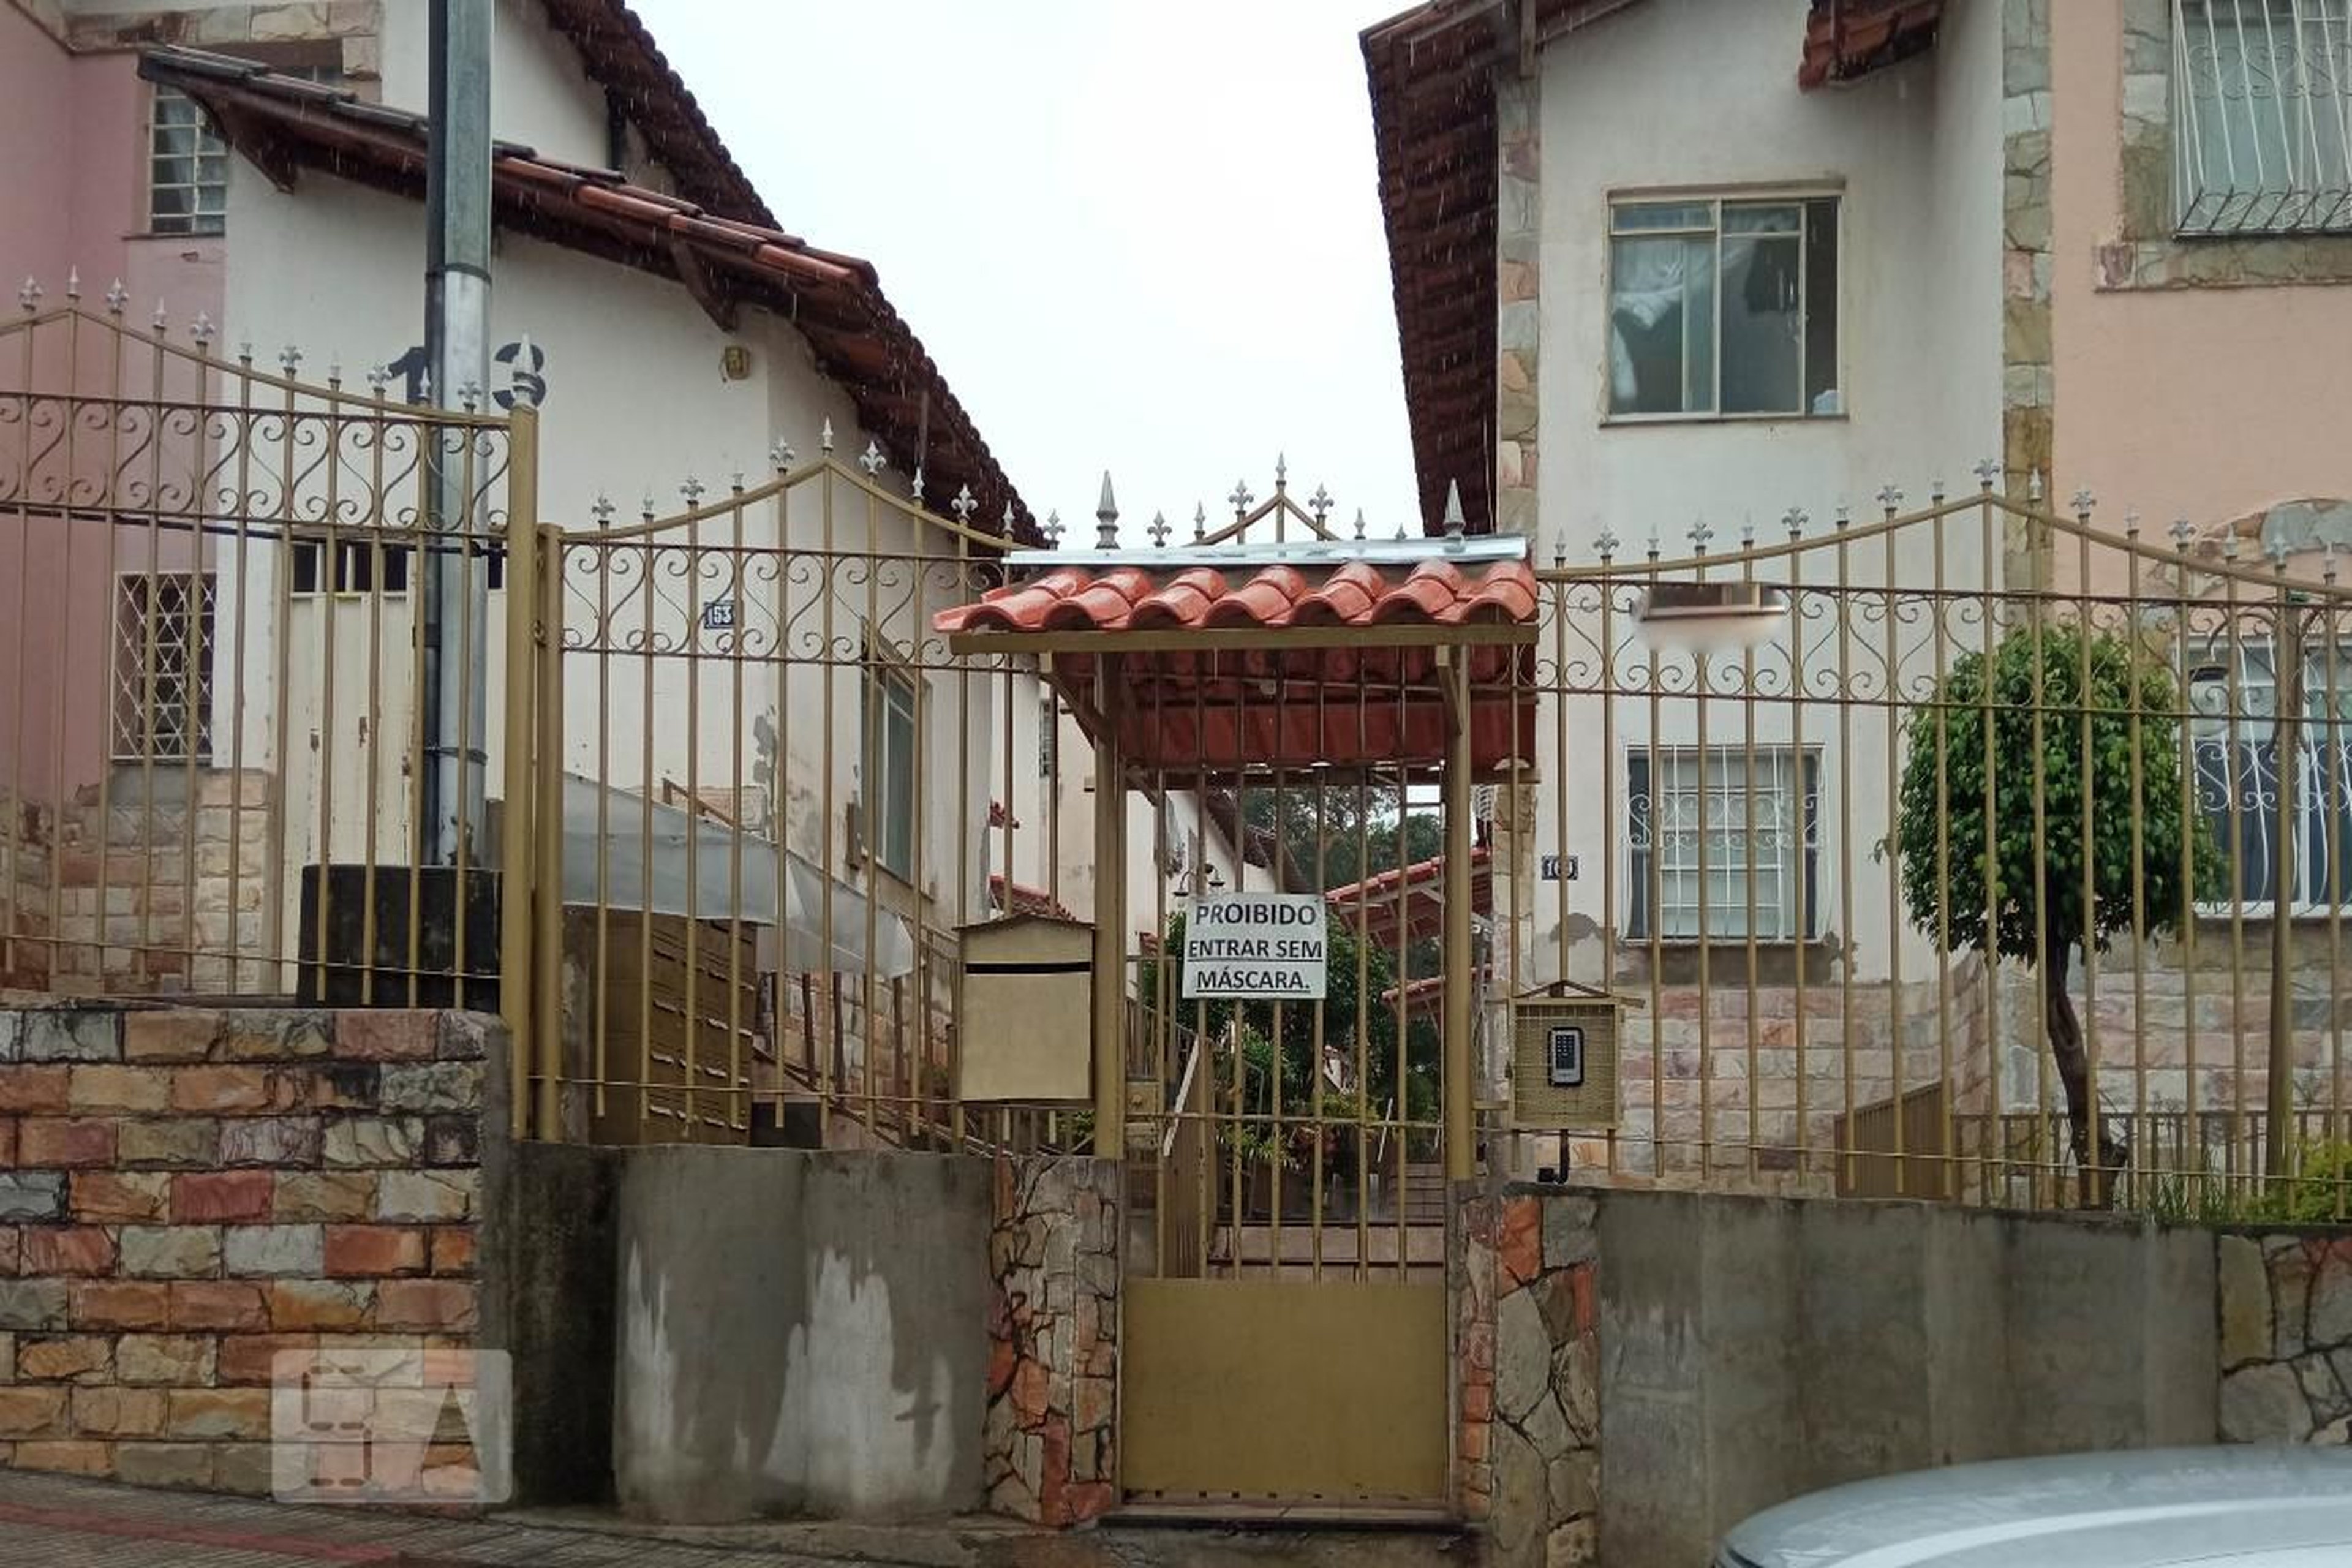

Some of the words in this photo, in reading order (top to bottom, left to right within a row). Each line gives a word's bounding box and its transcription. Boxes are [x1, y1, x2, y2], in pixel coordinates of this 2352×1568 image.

[387, 342, 546, 410] 13
[1196, 903, 1316, 925] PROIBIDO
[1189, 939, 1269, 957] ENTRAR
[1276, 940, 1322, 958] SEM
[1197, 966, 1310, 989] MÁSCARA.
